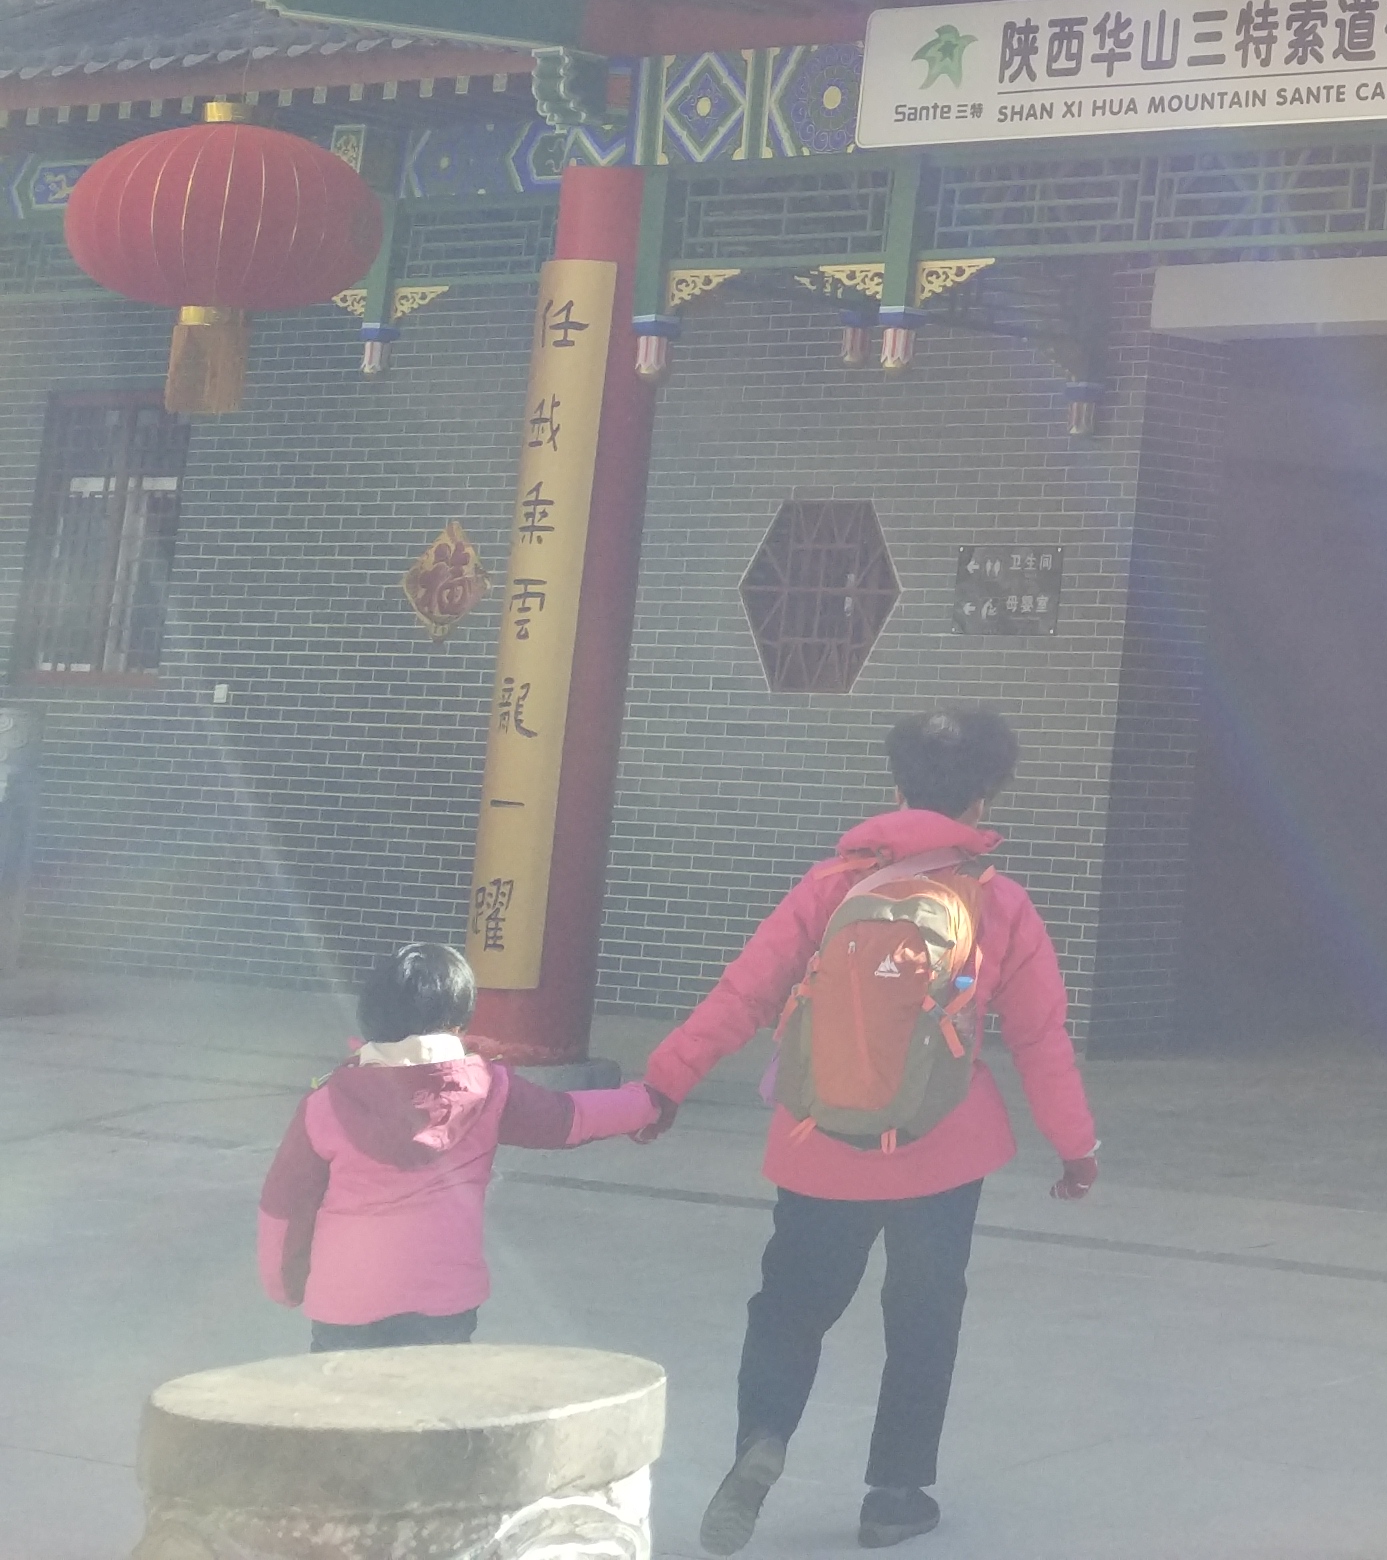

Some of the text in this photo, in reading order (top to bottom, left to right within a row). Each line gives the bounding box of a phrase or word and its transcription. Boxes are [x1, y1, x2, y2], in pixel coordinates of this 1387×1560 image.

[893, 102, 984, 123] Sante 三特
[997, 101, 1054, 124] SHAN
[1061, 99, 1082, 119] XI
[1091, 96, 1139, 118] HUA
[1147, 89, 1267, 115] MOUNTAIN
[1276, 85, 1347, 106] SANTE
[1009, 553, 1053, 571] 卫生间
[1006, 595, 1049, 613] 母婴室
